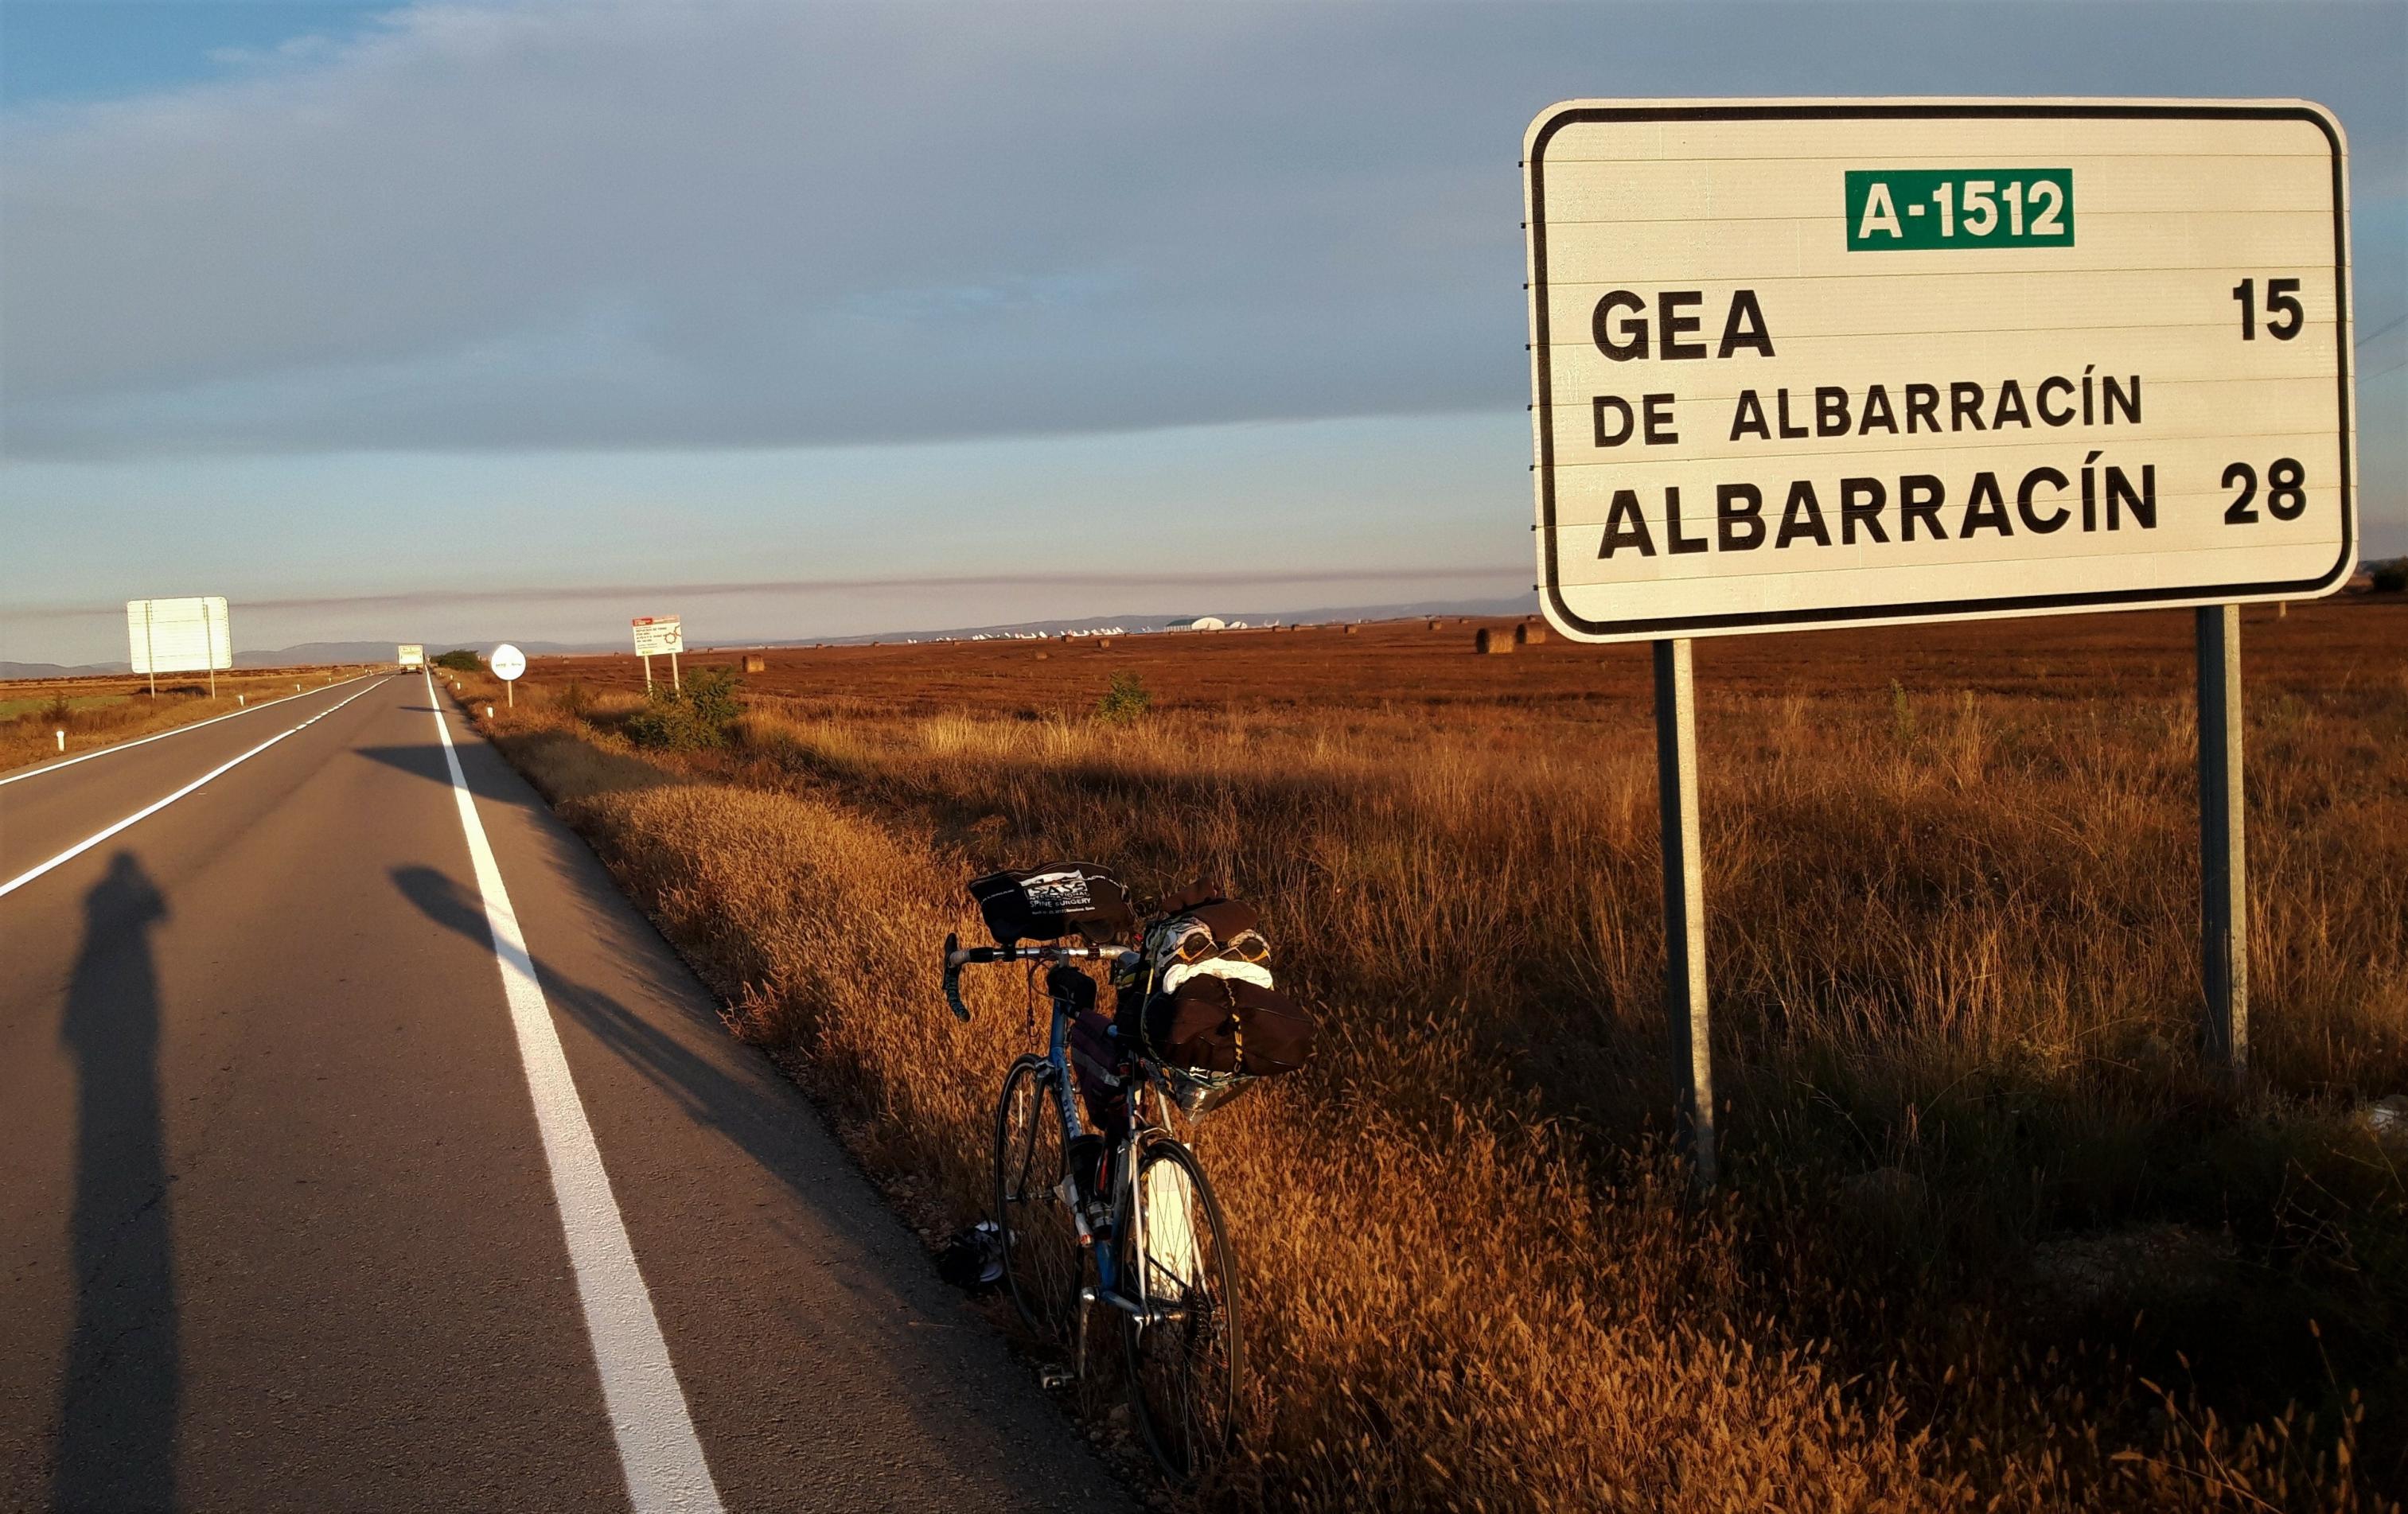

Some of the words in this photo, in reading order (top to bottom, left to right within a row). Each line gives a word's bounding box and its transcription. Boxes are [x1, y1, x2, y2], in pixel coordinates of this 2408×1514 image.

[1859, 181, 2064, 239] A-1512
[1592, 290, 1775, 362] GEA
[2232, 278, 2304, 341] 15
[1593, 393, 1679, 448] DE
[1729, 365, 2141, 442] ALBARRACÍN
[1597, 451, 2157, 559] ALBARRACÍN
[2221, 457, 2307, 525] 28
[1054, 898, 1092, 907] SURGERY
